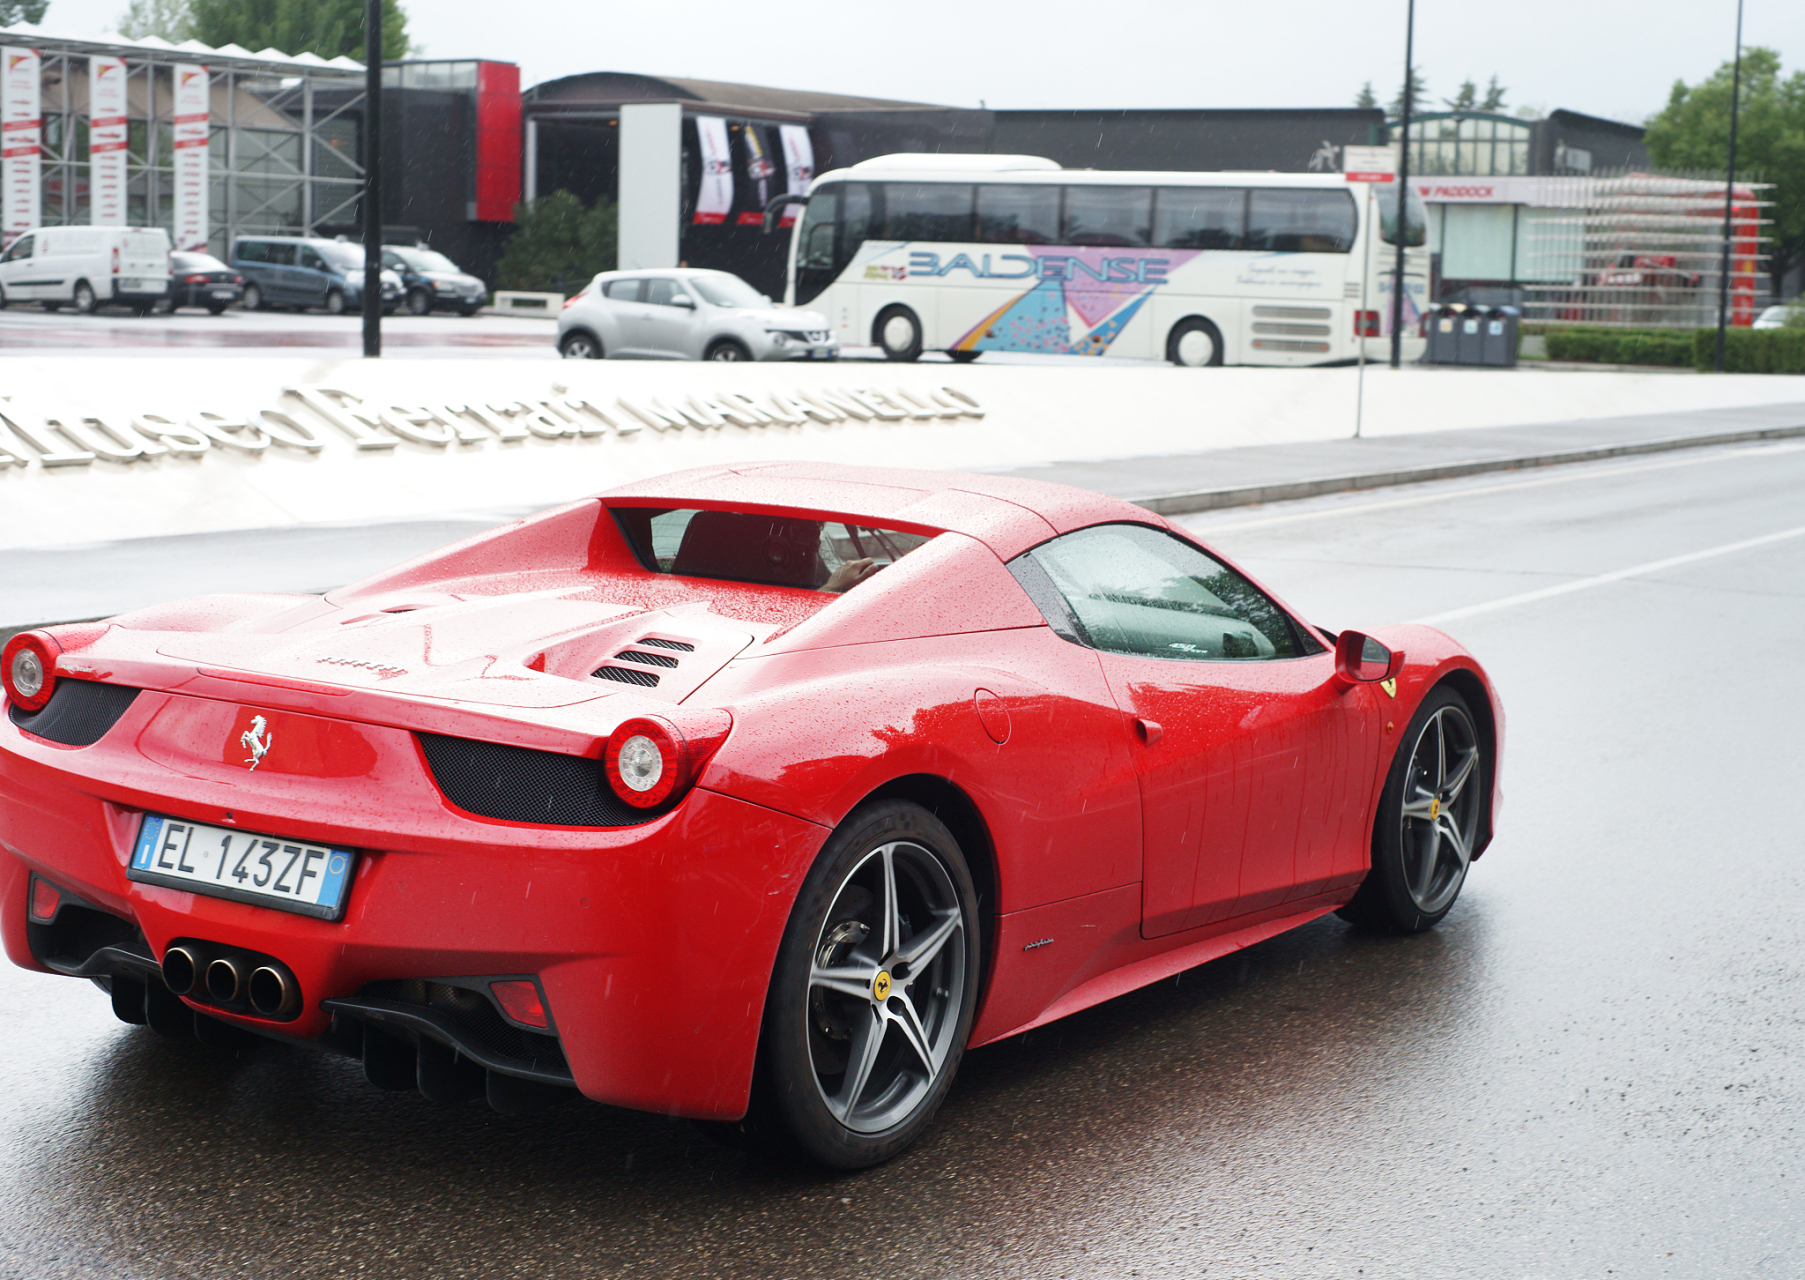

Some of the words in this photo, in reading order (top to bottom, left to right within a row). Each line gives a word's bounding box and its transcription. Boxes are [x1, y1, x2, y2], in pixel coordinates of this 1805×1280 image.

[1434, 186, 1494, 198] PADDOCK
[908, 251, 1170, 285] BALDENSE
[281, 384, 644, 452] Ferrari
[615, 386, 986, 432] MARANELLO
[157, 823, 195, 873] EL
[215, 835, 326, 895] 143ZF
